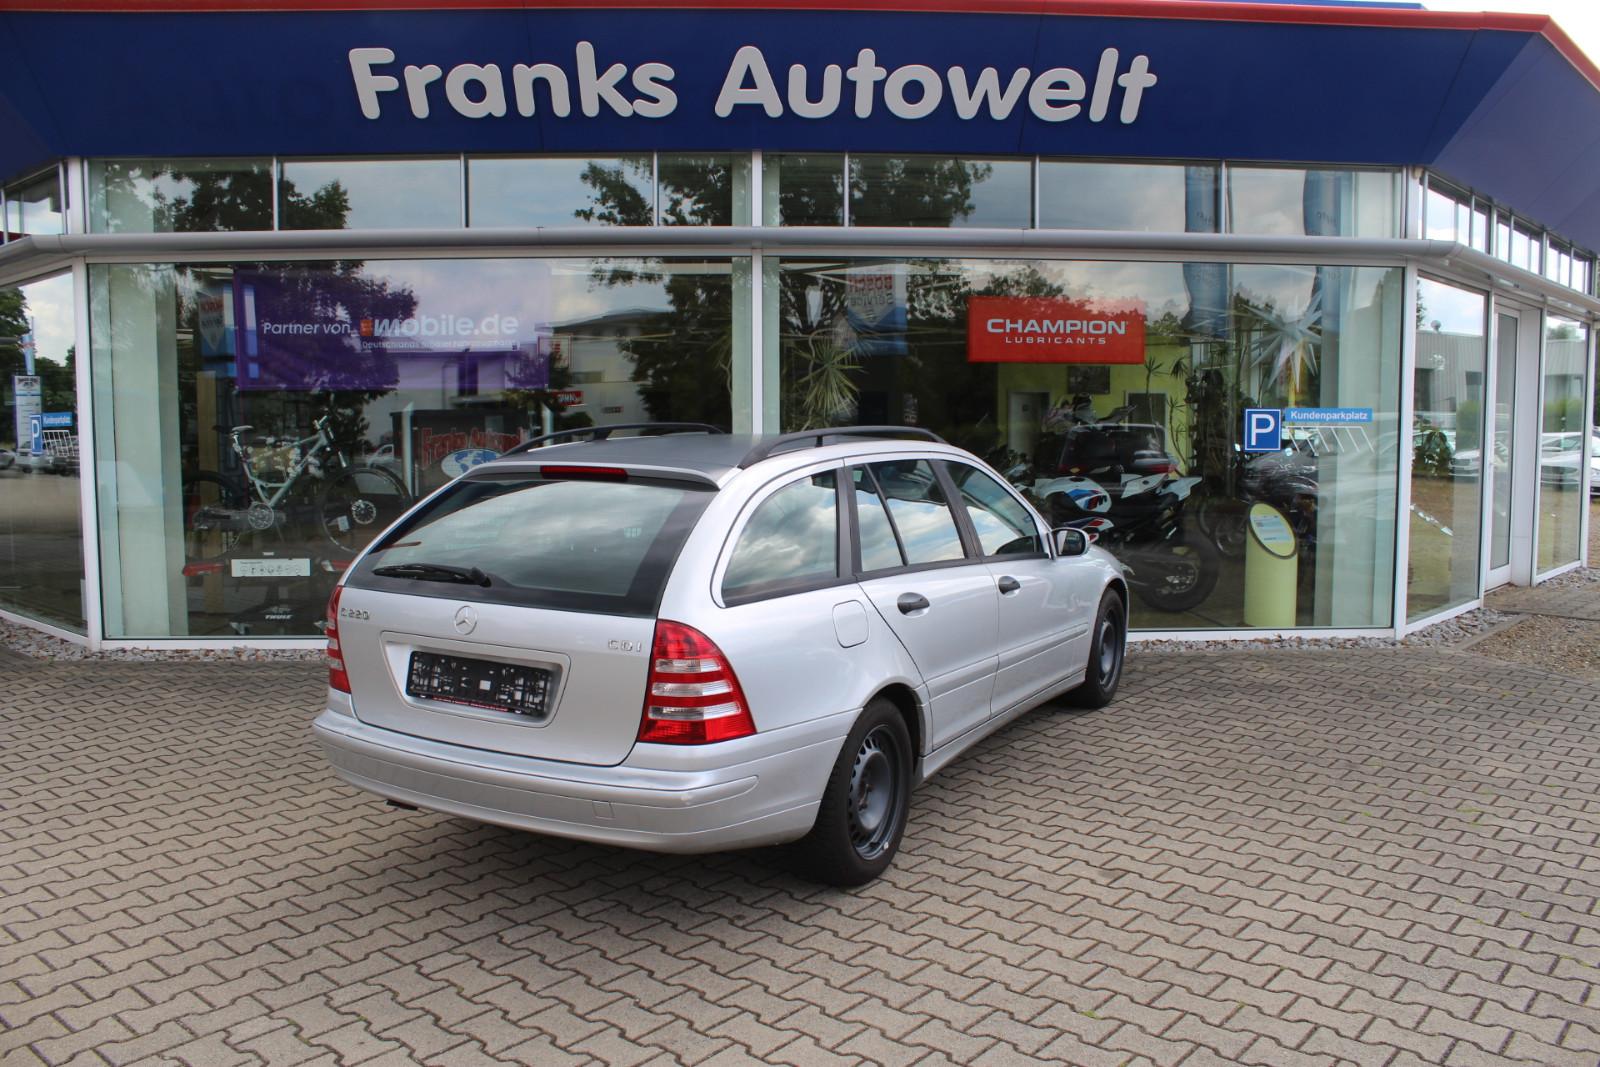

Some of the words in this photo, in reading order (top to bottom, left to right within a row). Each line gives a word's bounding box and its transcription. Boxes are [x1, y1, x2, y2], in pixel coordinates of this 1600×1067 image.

[348, 41, 678, 120] Franks
[714, 45, 1158, 124] Autowelt
[263, 322, 320, 335] Partner
[323, 323, 351, 335] von
[374, 314, 519, 337] mobile.de
[986, 318, 1127, 335] CHAMPION
[1005, 336, 1106, 345] LUBRICANTS
[1290, 410, 1368, 421] Kundenparkplatz
[1251, 413, 1276, 446] P
[608, 639, 642, 653] CDI
